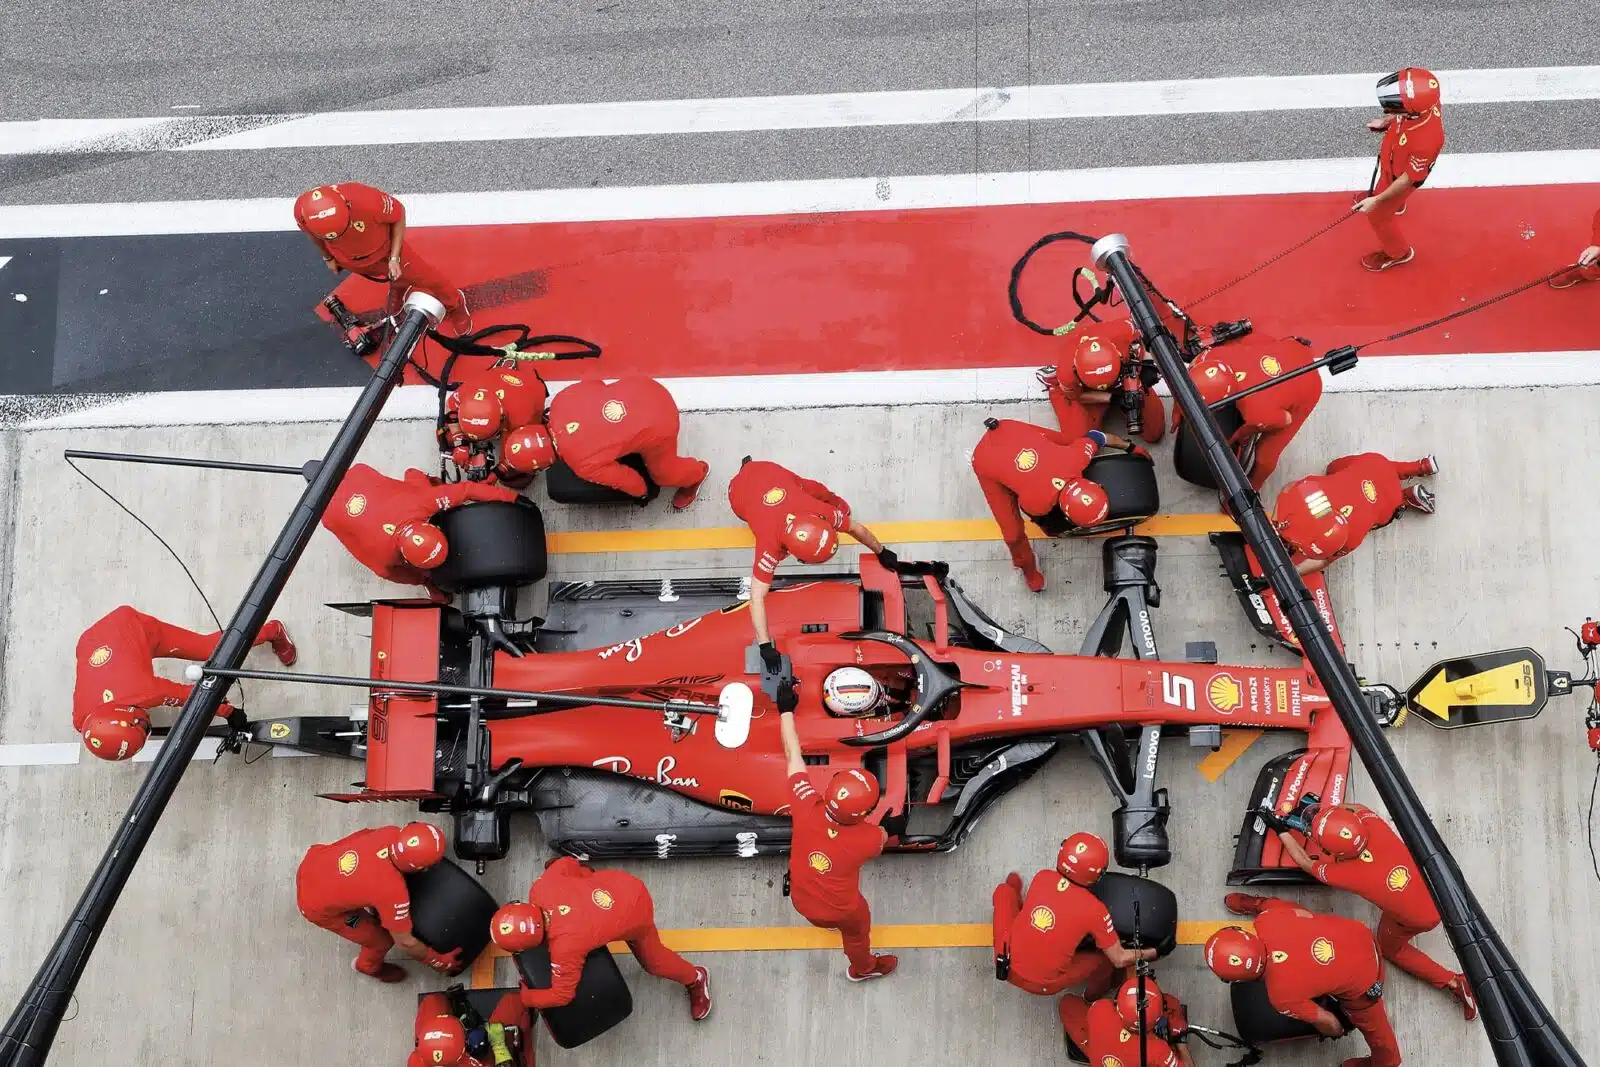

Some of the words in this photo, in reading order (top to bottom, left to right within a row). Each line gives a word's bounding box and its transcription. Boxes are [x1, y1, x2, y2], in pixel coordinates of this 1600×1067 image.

[598, 617, 701, 662] R-Ban
[1140, 610, 1157, 656] Lenovo
[1162, 671, 1196, 711] 5
[1250, 683, 1258, 713] AMD
[1290, 678, 1300, 717] MAHLE
[592, 756, 699, 788] R-Ban
[1143, 730, 1160, 779] Lenovo
[1286, 760, 1308, 802] V-Power
[1330, 774, 1343, 806] ightcap
